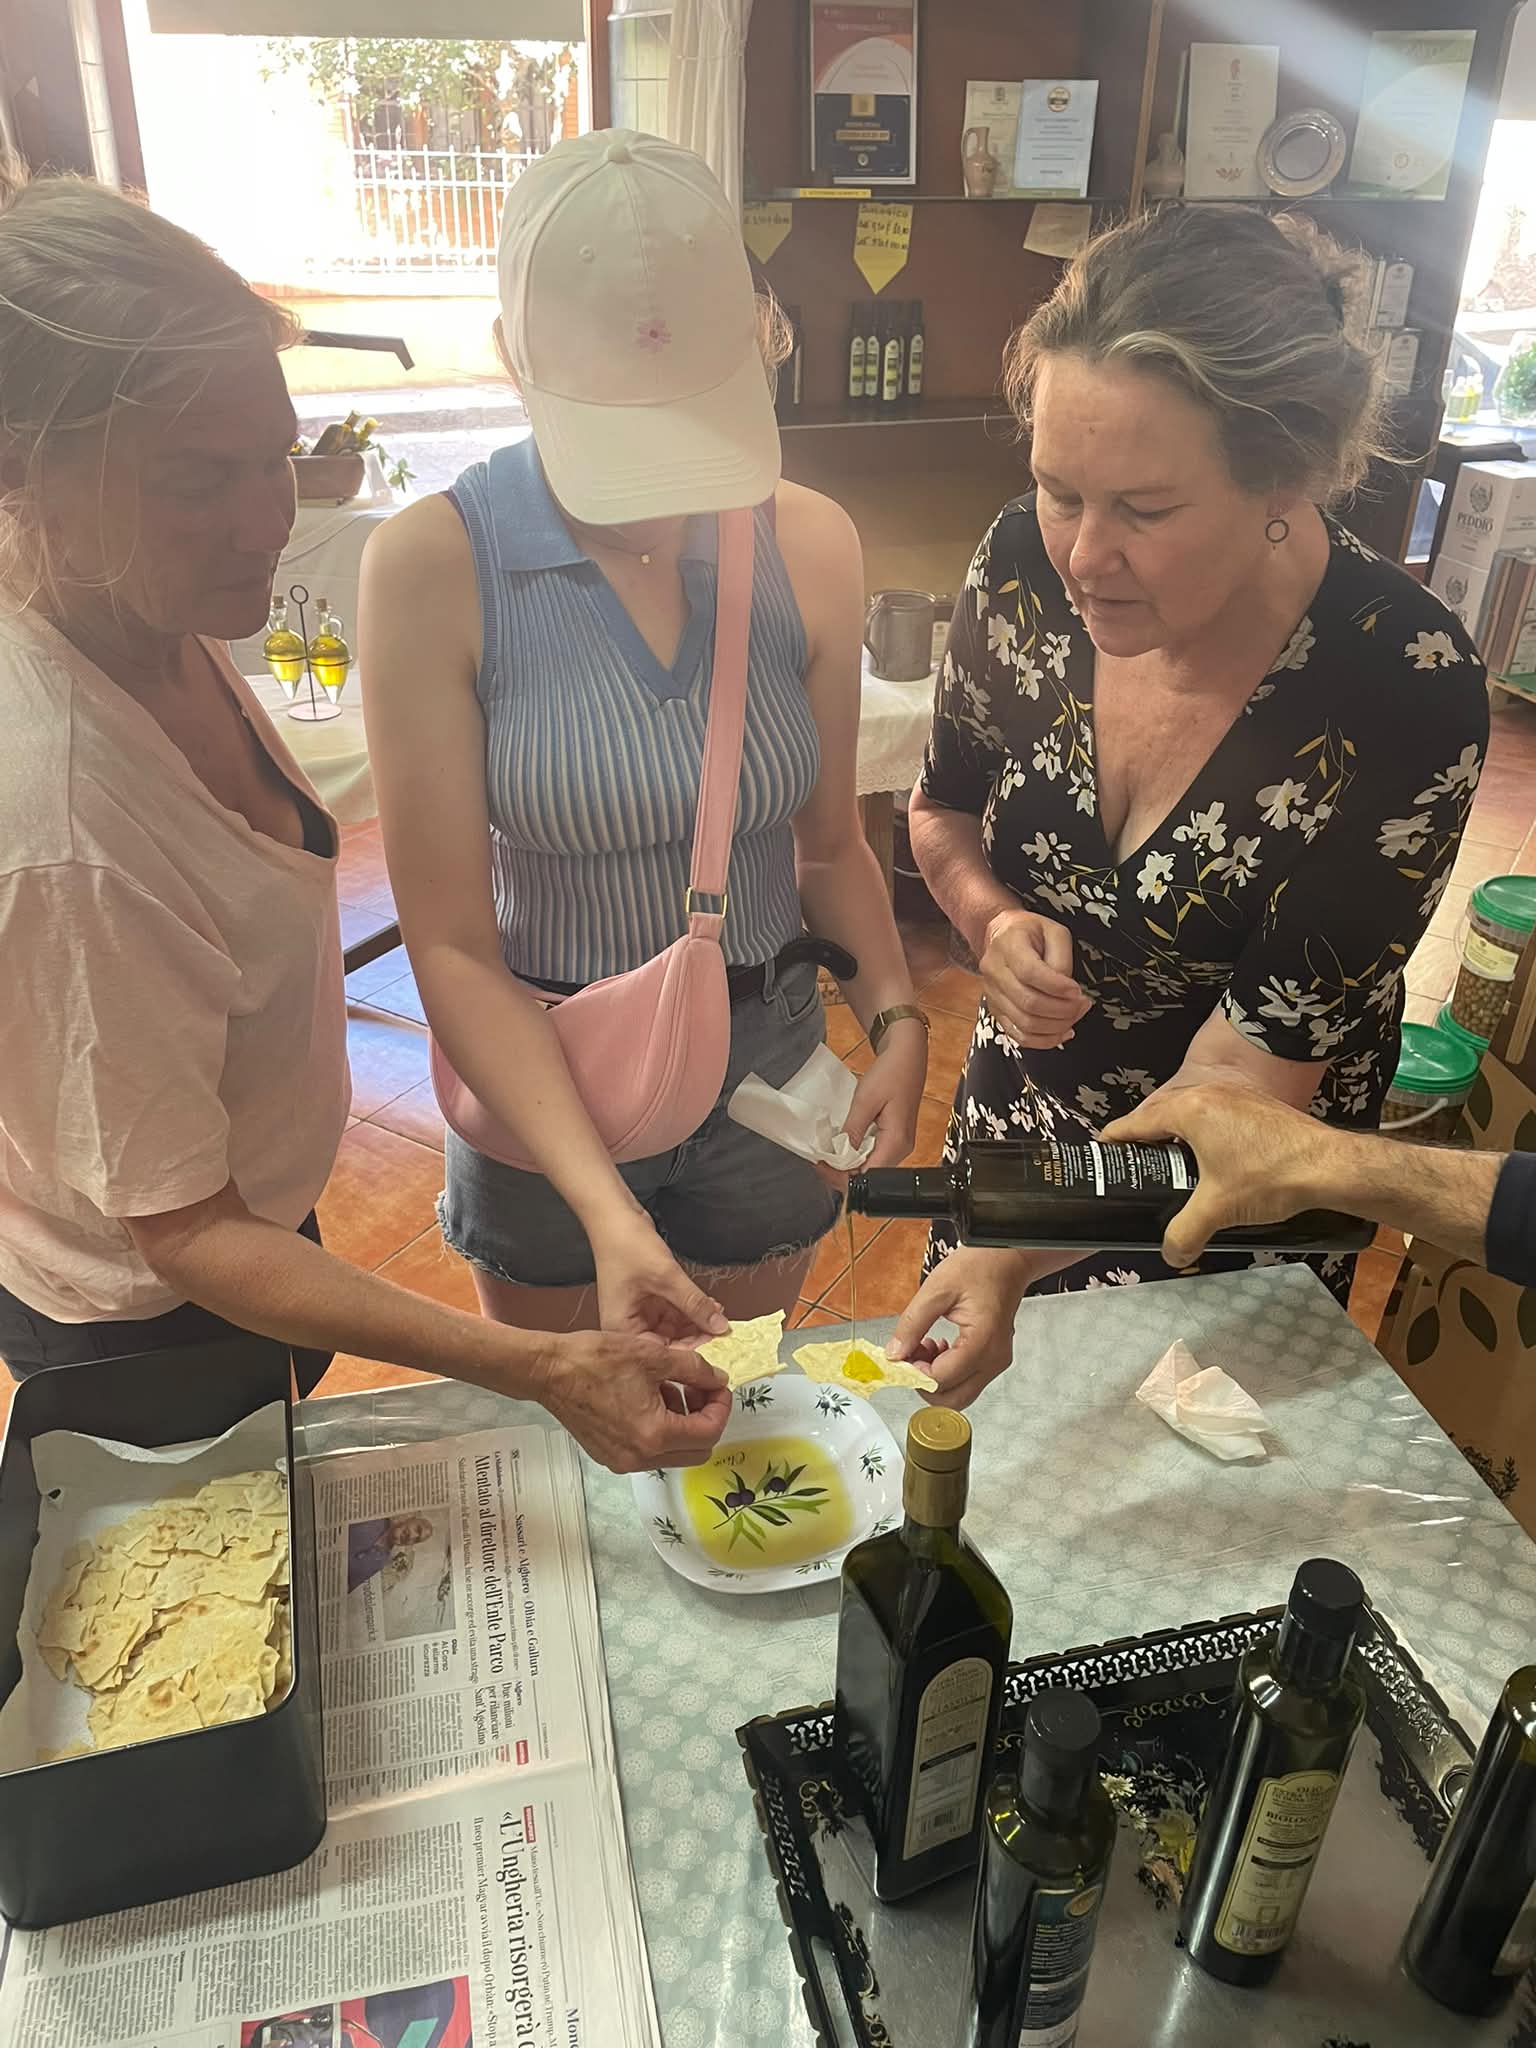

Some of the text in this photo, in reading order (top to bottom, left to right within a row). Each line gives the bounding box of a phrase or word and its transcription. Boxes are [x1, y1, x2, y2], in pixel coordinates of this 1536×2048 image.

[1457, 512, 1494, 531] PEDDIO
[515, 1513, 528, 1547] Sassari
[475, 1455, 506, 1674] Attentato al direttore dell'Ente Parco
[518, 1557, 531, 1594] Alghero
[524, 1600, 536, 1628] Olbia
[528, 1637, 540, 1676] Gallura
[473, 1688, 487, 1745] Sant'Agostino
[485, 1686, 502, 1740] per rilanciare
[502, 1682, 516, 1728] Due milioni
[474, 1816, 484, 1824] Il
[474, 1824, 482, 1840] neo
[472, 1841, 486, 1877] premier
[496, 1811, 530, 1933] «L'Ungheria
[531, 1846, 539, 1866] Mano
[476, 1878, 488, 1914] Magyar
[480, 1914, 491, 1940] avvia
[482, 1940, 493, 1948] il
[480, 1948, 493, 1972] dopo
[539, 1932, 550, 1970] chiamerò
[505, 1935, 541, 2037] risorgerà
[542, 1970, 551, 1994] Putin
[486, 2010, 498, 2040] «Stop
